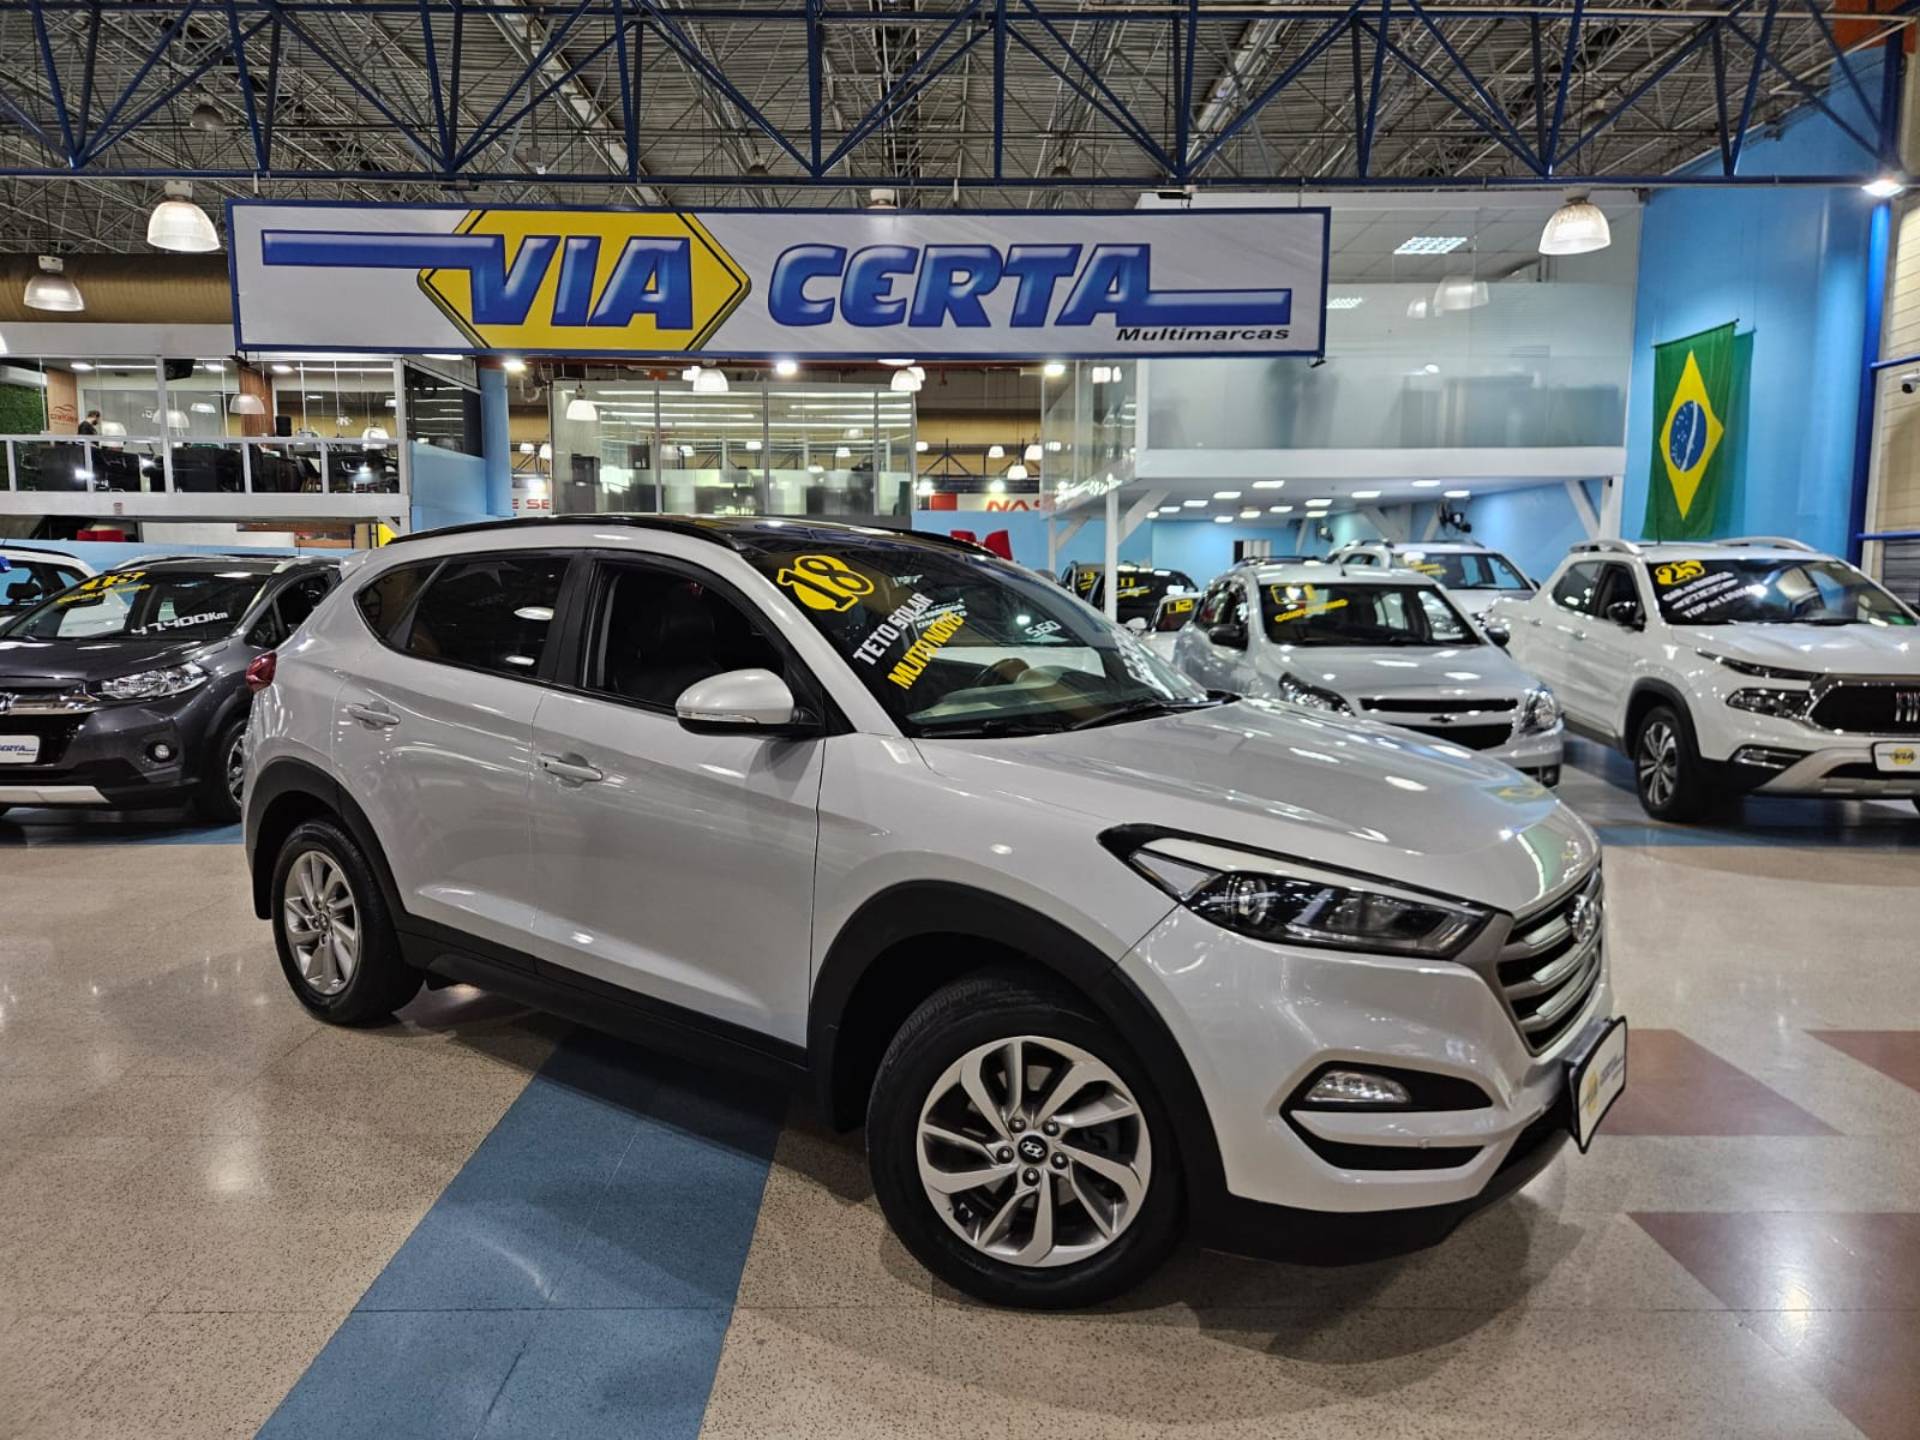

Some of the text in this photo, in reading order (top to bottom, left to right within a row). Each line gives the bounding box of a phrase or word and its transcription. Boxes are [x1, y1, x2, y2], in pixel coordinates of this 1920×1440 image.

[767, 242, 1151, 329] CERTA
[1116, 328, 1291, 342] Multimarcas
[778, 554, 873, 611] 18
[852, 617, 900, 665] TETO
[888, 592, 934, 631] SOLAR
[887, 633, 938, 690] MUITO
[922, 609, 966, 651] NOVO
